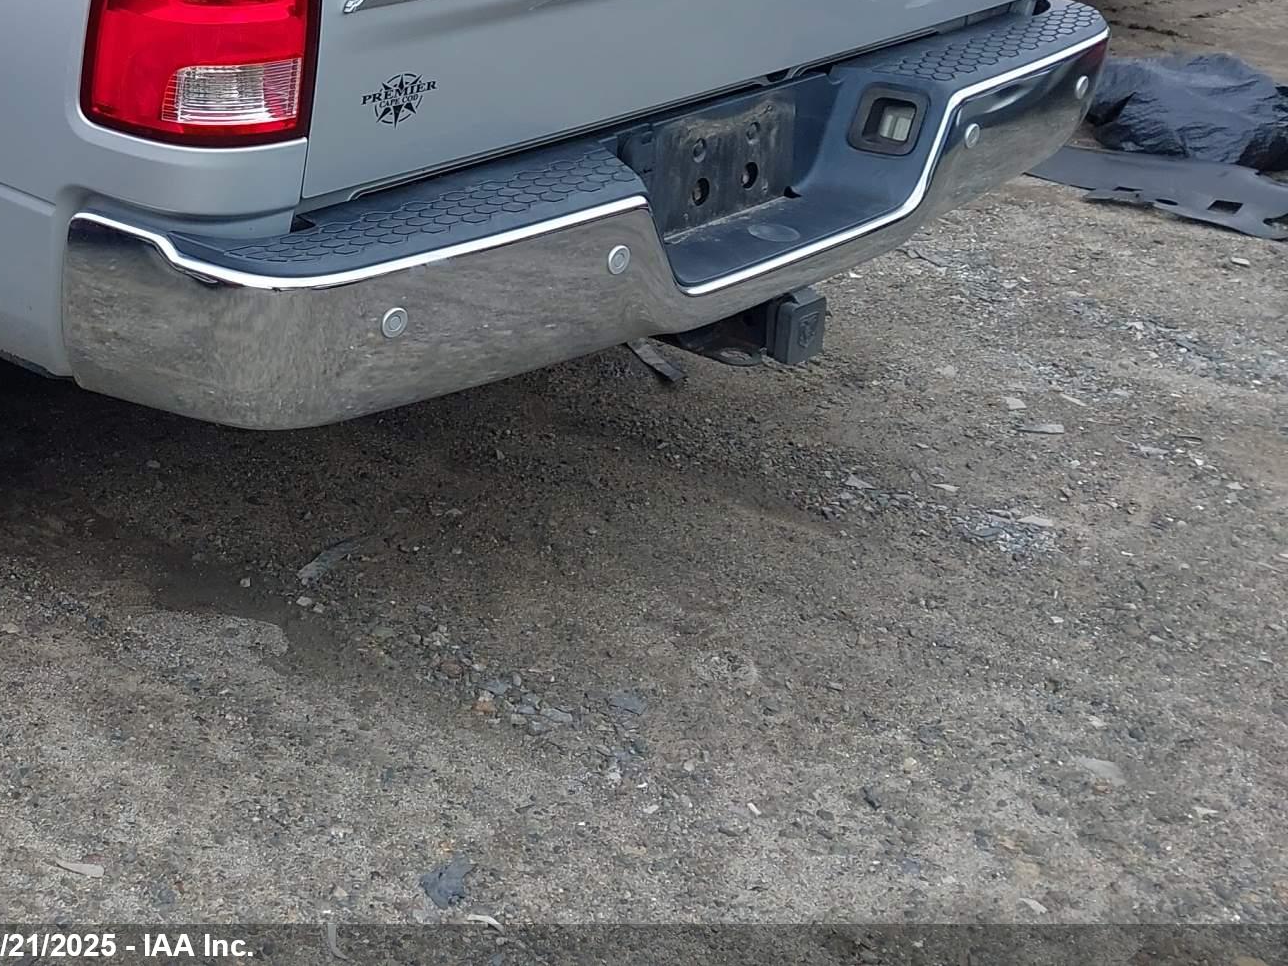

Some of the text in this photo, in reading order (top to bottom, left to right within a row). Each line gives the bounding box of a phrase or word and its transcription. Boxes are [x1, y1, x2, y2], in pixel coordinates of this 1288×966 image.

[360, 80, 438, 106] PREMIER
[379, 93, 419, 109] CAPE COD
